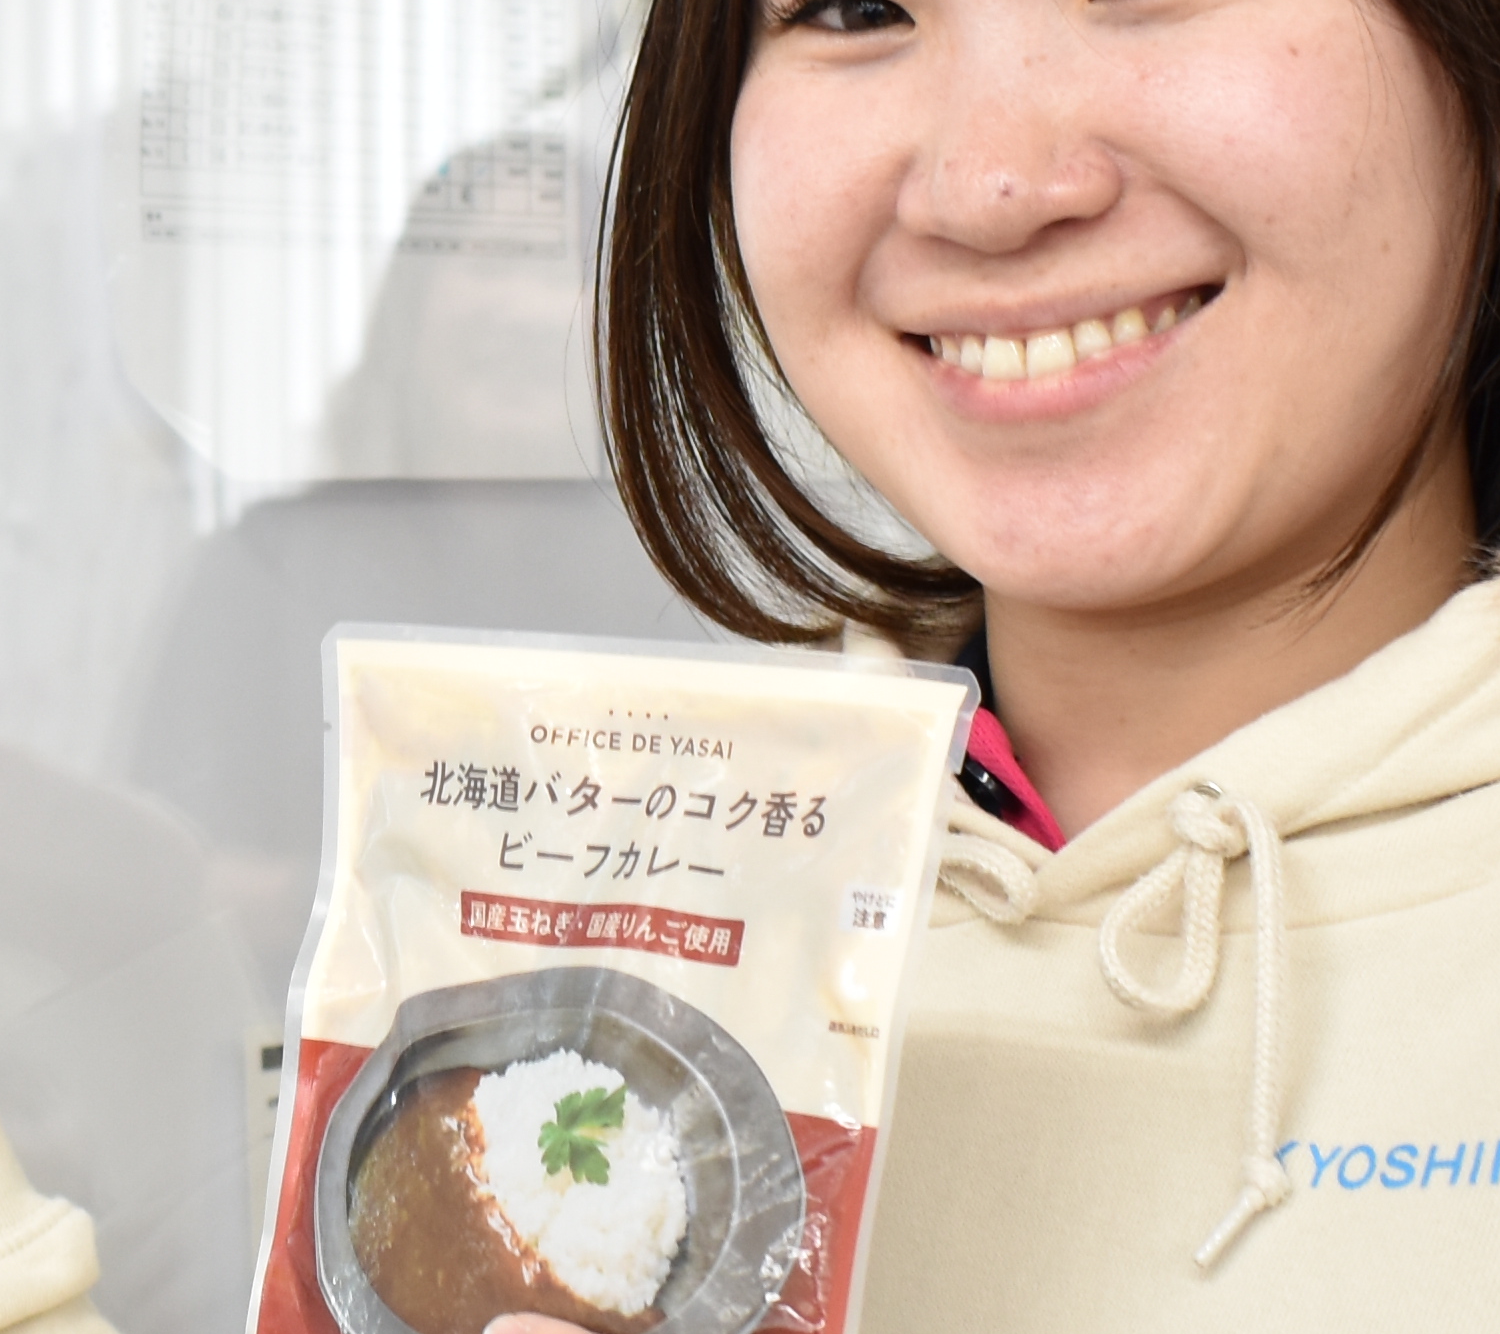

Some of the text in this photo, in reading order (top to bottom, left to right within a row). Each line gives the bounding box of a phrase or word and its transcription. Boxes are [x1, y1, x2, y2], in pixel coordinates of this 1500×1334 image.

[529, 722, 736, 762] OFFICE DE YASAI
[419, 759, 829, 842] 北海道バターのコク香る
[498, 832, 726, 880] ビーフカレー
[469, 898, 733, 958] 国産玉ねぎ・国産りんご使用
[851, 907, 888, 932] 注意
